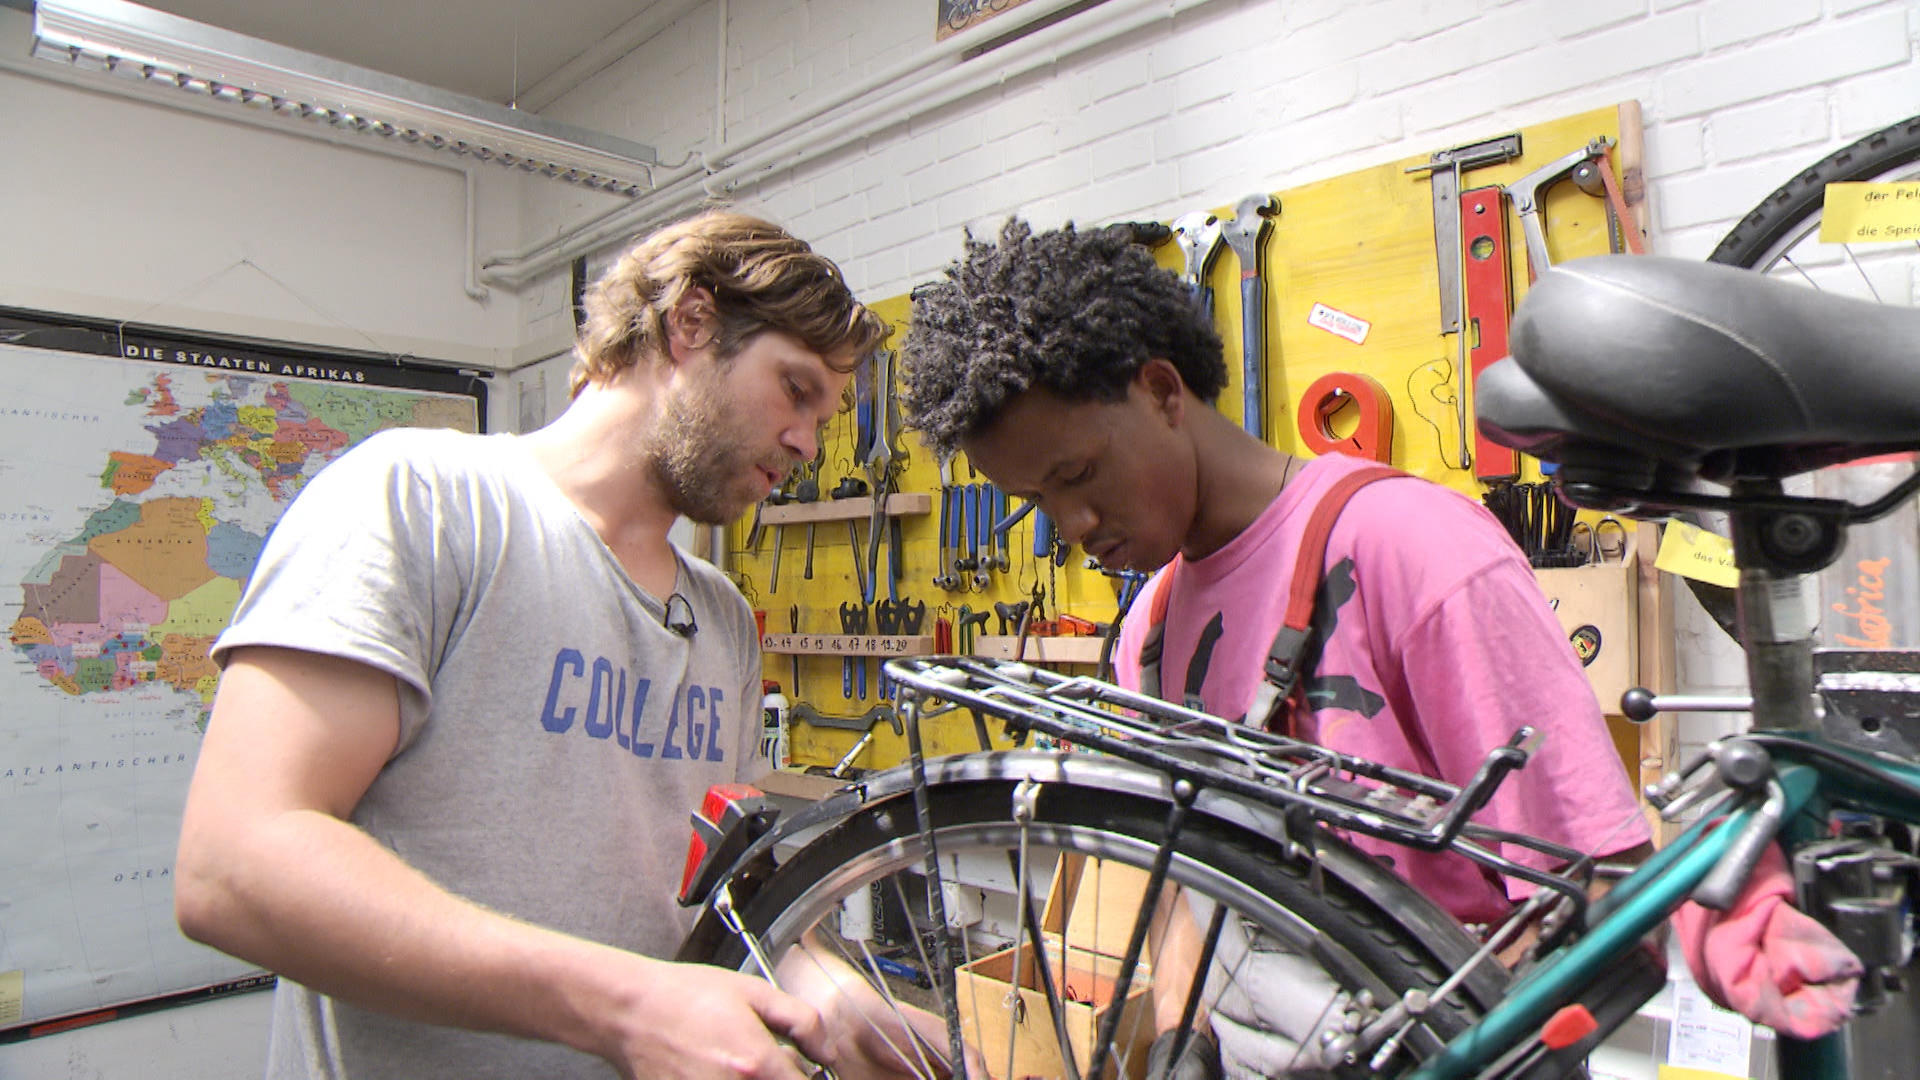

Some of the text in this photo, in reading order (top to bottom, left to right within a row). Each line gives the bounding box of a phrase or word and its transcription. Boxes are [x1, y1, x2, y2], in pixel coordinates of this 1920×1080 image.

[1864, 191, 1889, 202] der
[1856, 225, 1878, 237] die
[126, 344, 365, 382] DIE STAATEN AFRIKAS
[782, 637, 792, 648] 14
[800, 636, 809, 649] 15
[831, 639, 842, 650] 16
[848, 637, 860, 651] 17
[865, 639, 876, 651] 18
[540, 647, 725, 762] COLLEGE
[6, 753, 186, 778] ATLANTISCHER
